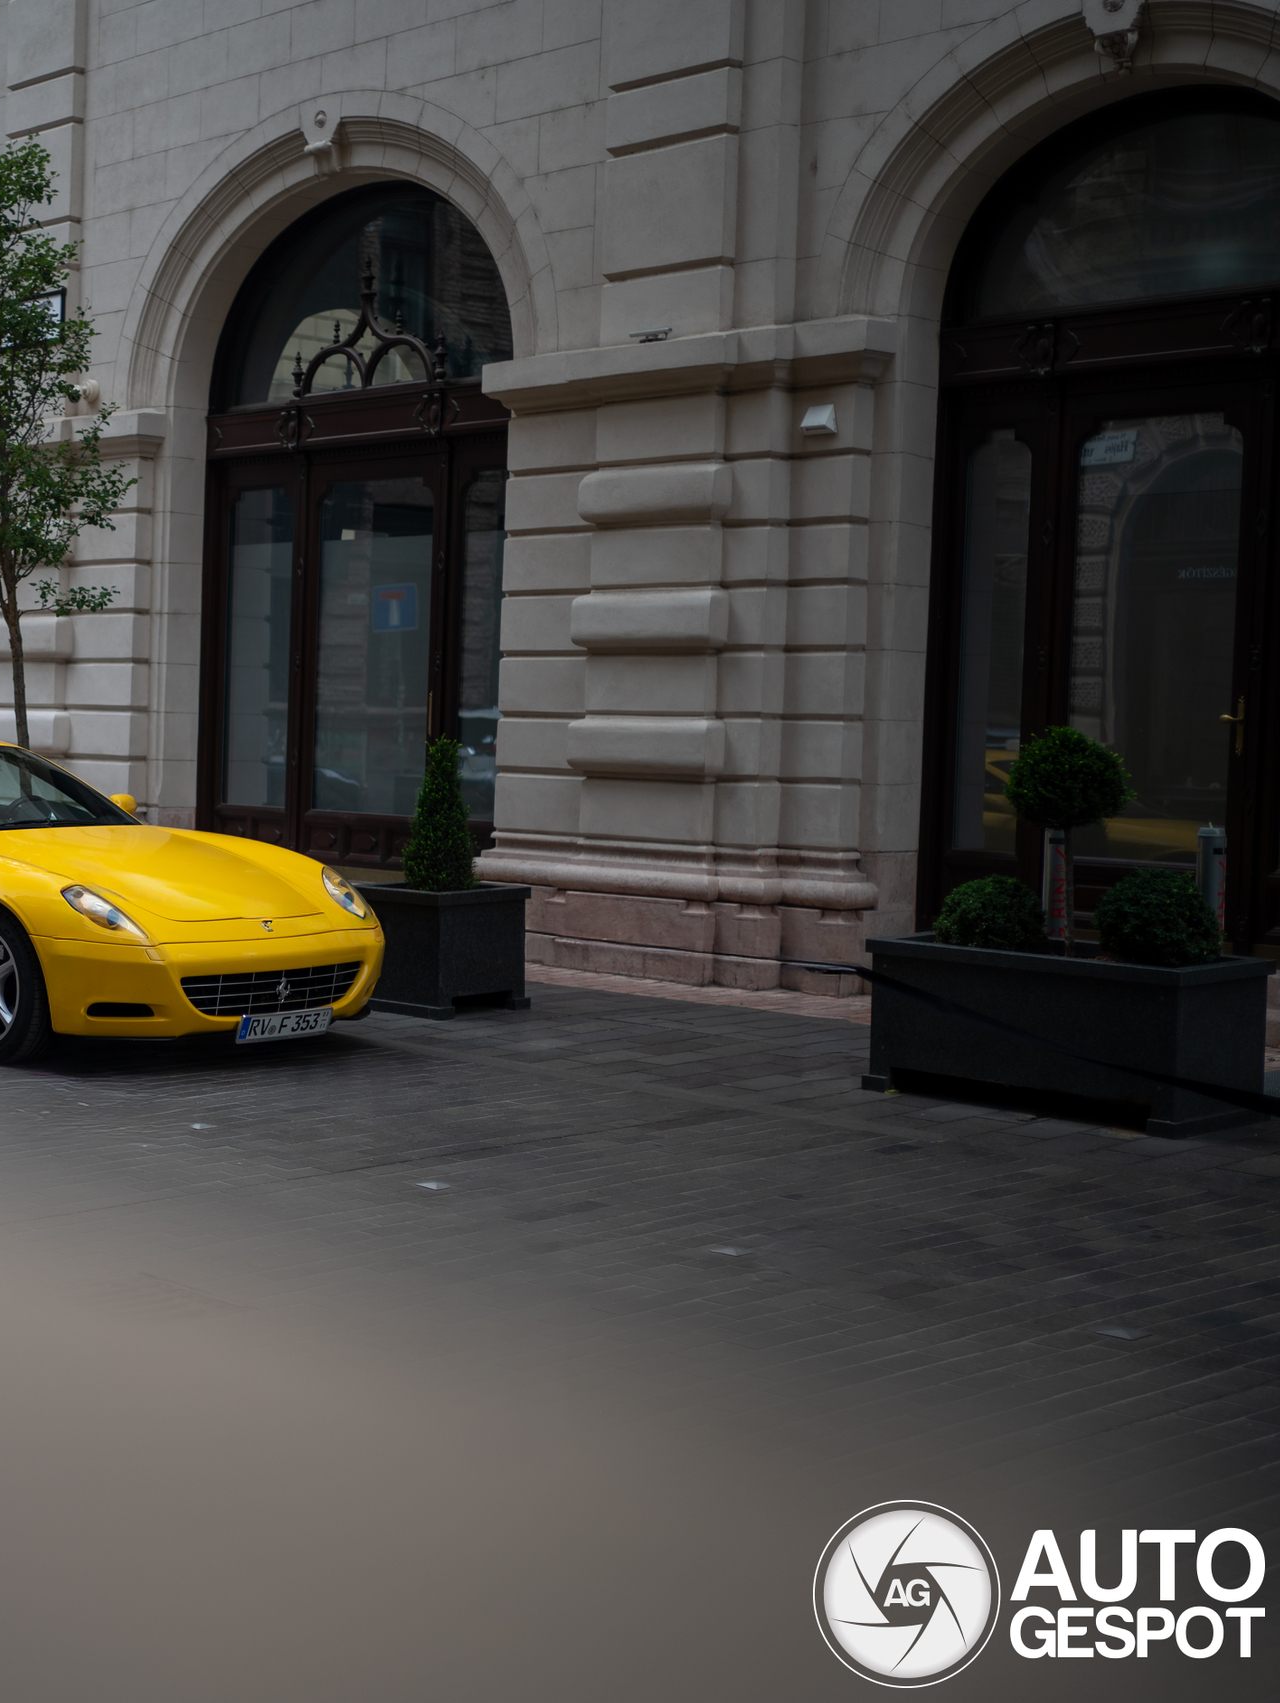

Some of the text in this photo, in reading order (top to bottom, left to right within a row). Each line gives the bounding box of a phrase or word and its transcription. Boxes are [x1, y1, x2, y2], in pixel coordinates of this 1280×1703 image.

[248, 1013, 321, 1037] RV F 353
